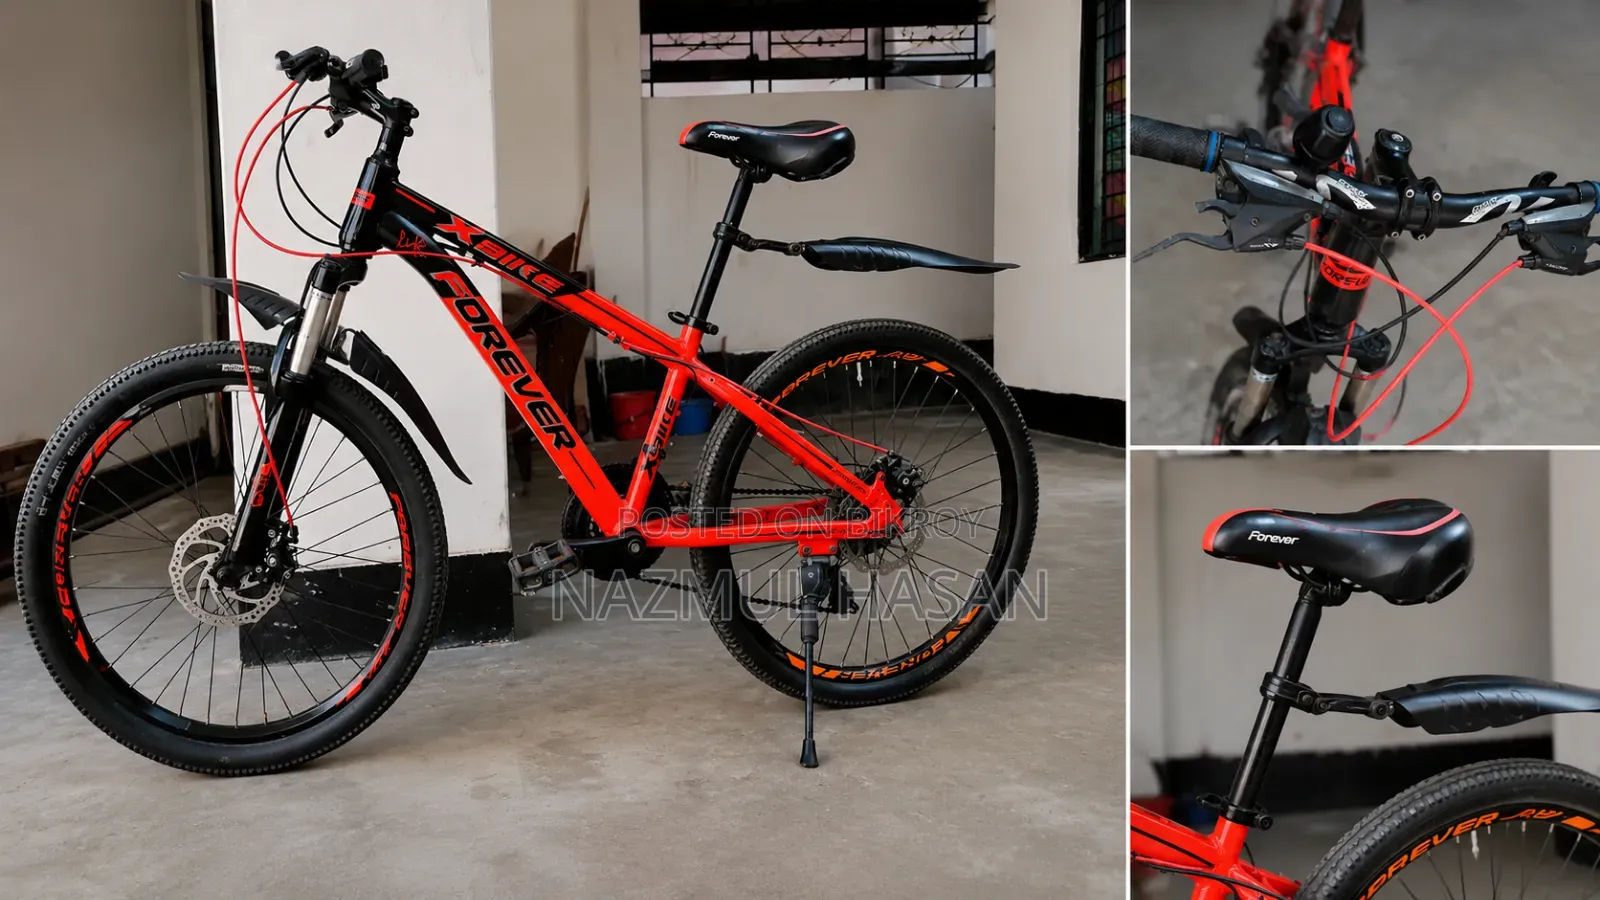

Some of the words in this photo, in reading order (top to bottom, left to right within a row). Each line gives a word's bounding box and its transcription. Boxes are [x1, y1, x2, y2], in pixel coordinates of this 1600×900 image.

[707, 130, 740, 141] Forever
[429, 269, 577, 450] FOREVER
[1247, 530, 1300, 545] Forever
[1357, 811, 1500, 900] OREVER
